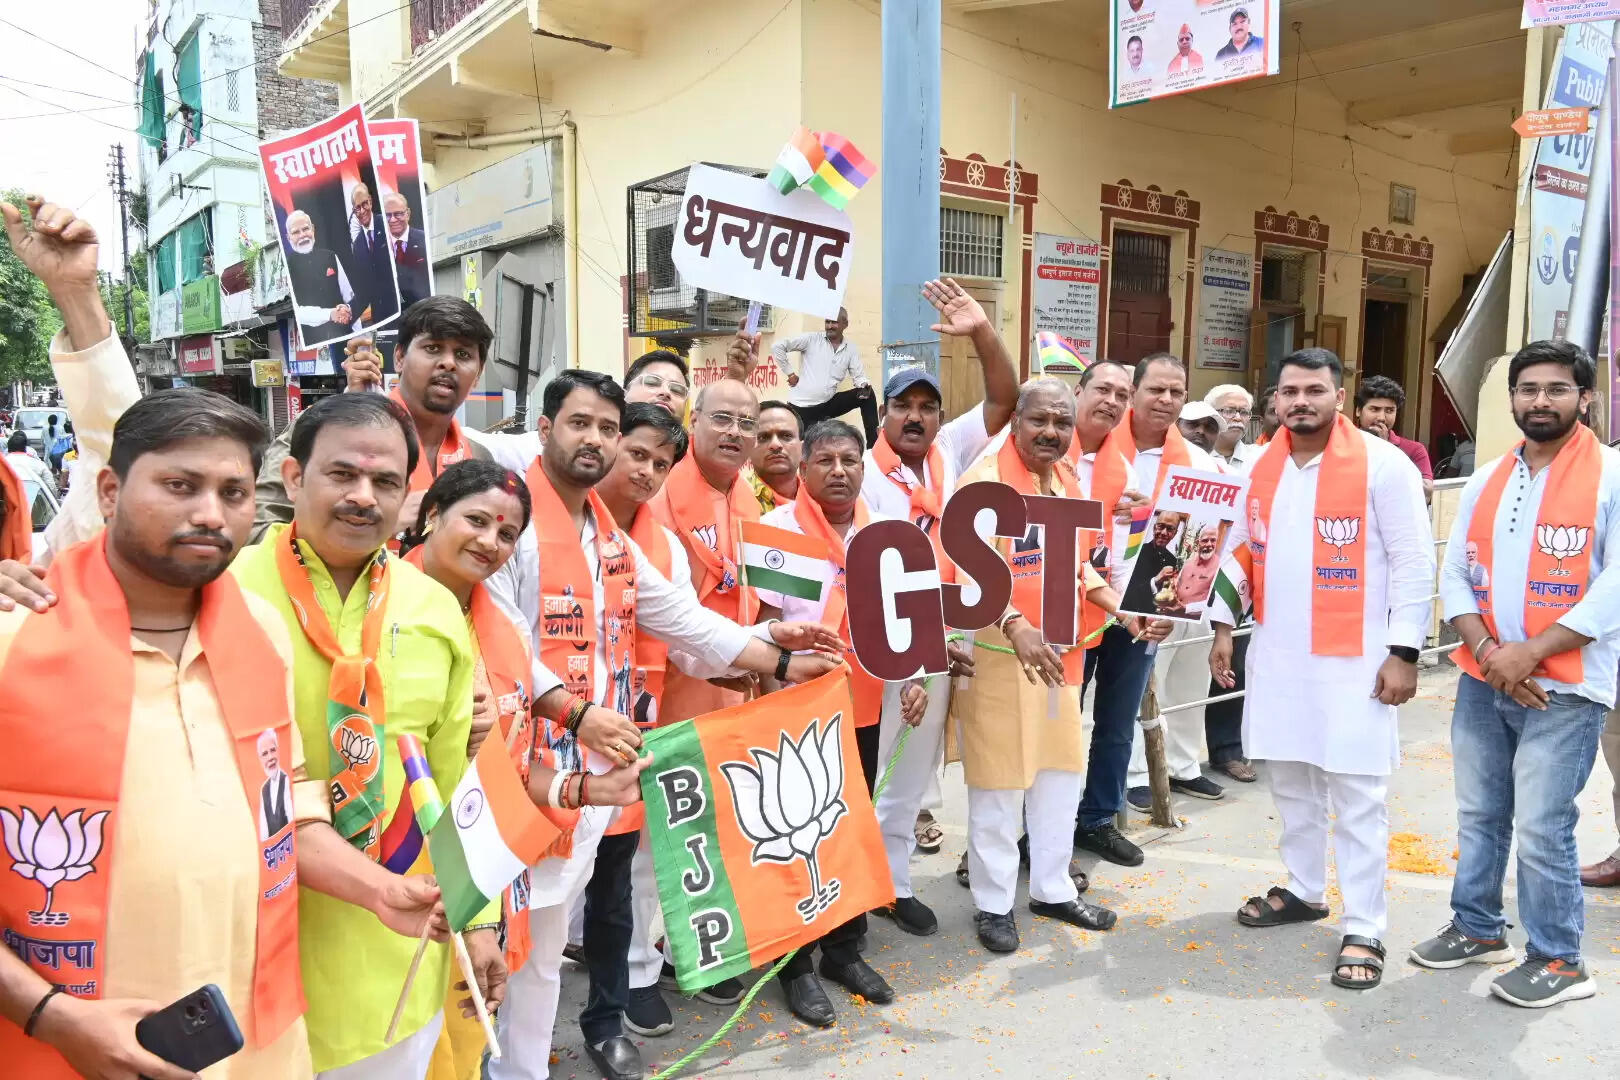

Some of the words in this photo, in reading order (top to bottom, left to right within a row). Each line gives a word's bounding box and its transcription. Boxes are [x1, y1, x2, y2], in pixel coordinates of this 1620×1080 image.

[268, 119, 362, 184] स्वागतम
[684, 194, 850, 290] धन्यवाद
[1169, 475, 1242, 508] स्वागतम
[845, 481, 1104, 681] GST
[1316, 566, 1357, 580] भाजपा
[1529, 580, 1579, 597] भाजपा
[656, 765, 732, 970] BJP
[4, 928, 97, 970] भाजपा
[69, 981, 96, 995] पार्टी
